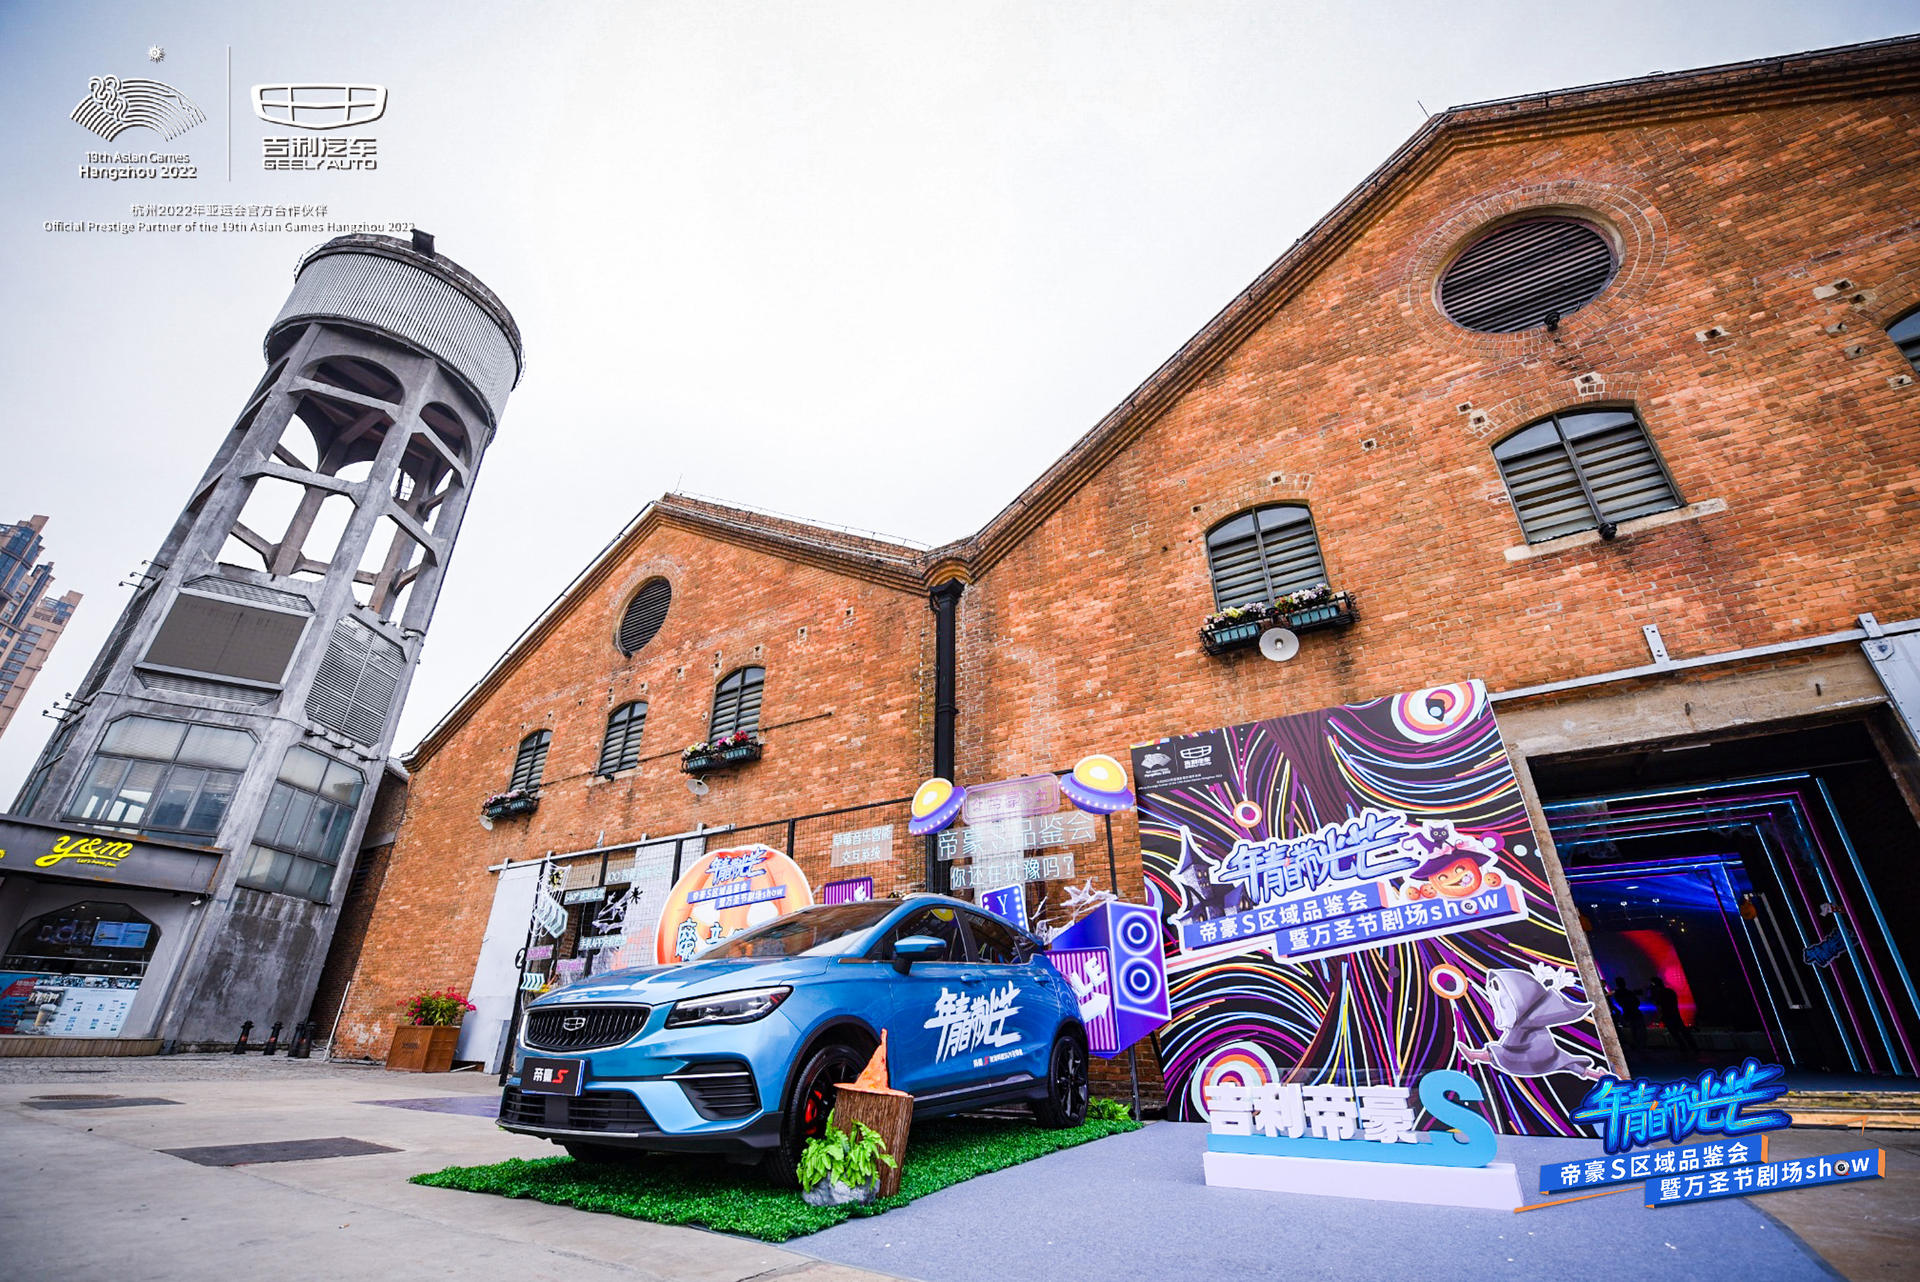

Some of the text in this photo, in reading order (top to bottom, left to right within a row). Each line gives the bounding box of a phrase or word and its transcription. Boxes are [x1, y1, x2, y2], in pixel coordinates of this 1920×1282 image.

[1199, 890, 1368, 944] 帝豪S区域品鉴会
[1289, 893, 1499, 951] 暨万圣节剧场show
